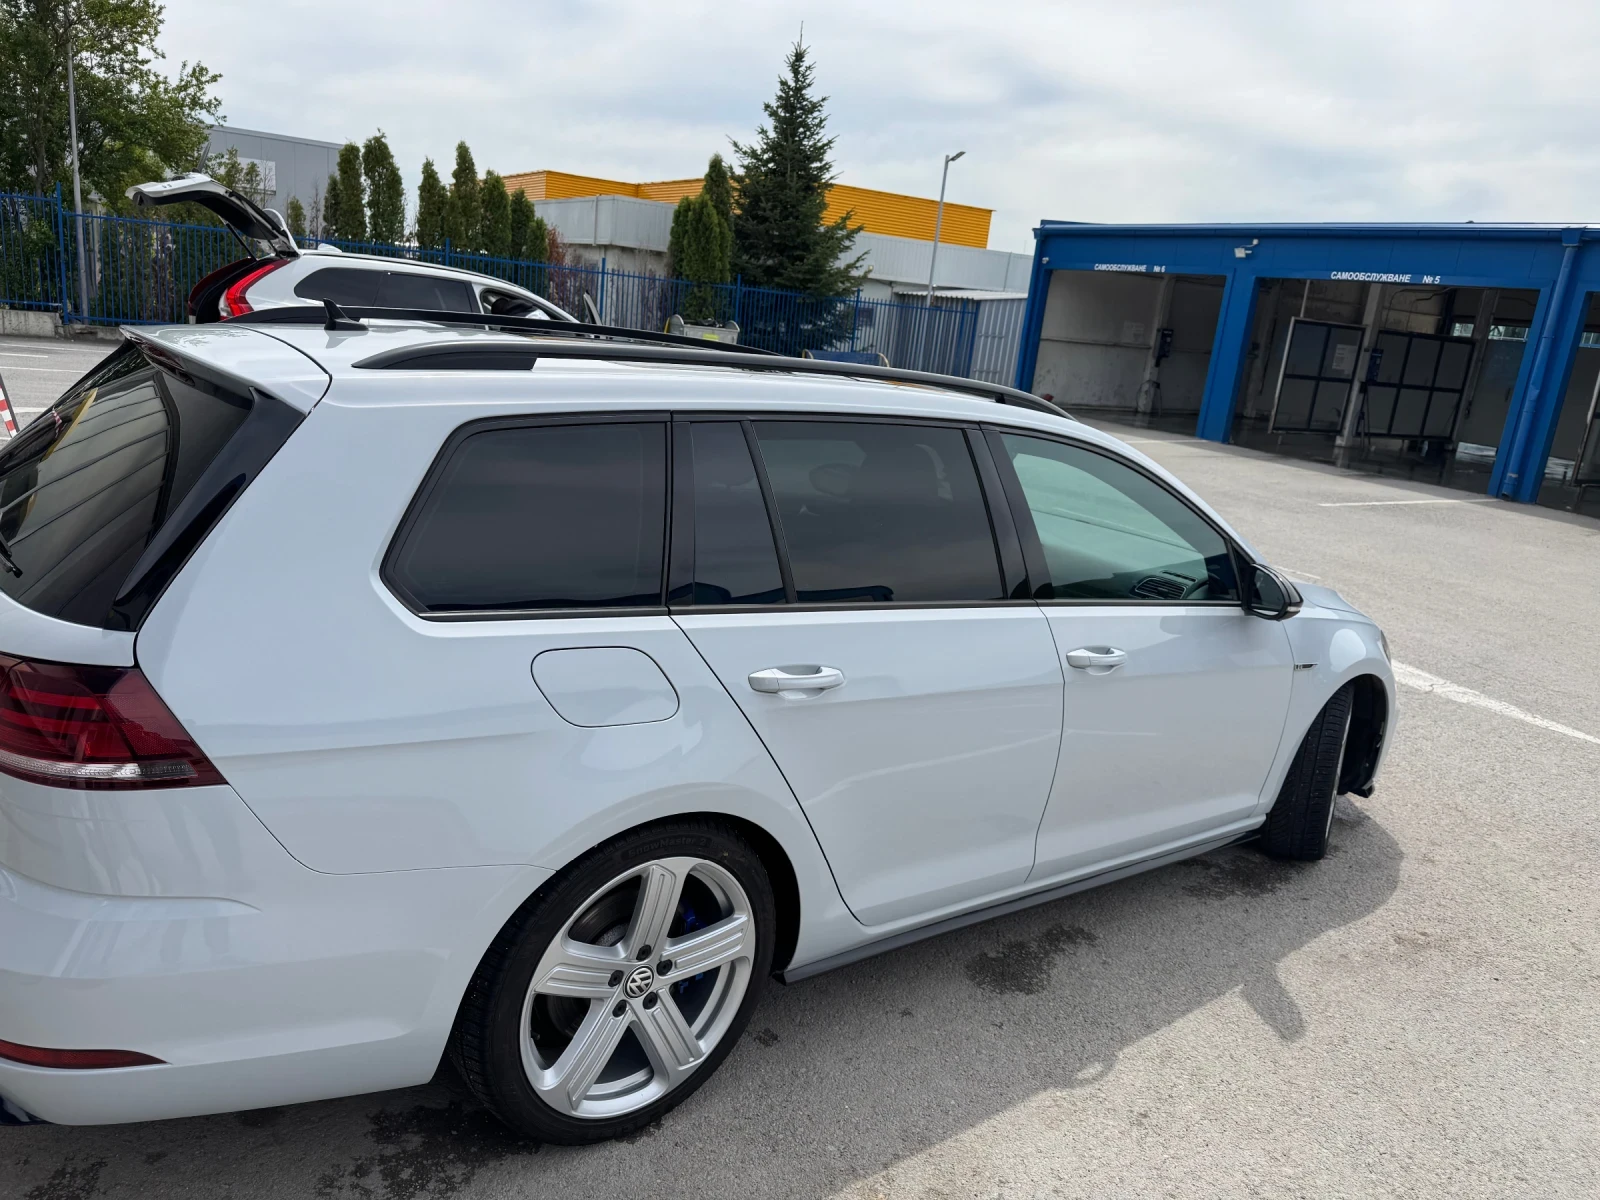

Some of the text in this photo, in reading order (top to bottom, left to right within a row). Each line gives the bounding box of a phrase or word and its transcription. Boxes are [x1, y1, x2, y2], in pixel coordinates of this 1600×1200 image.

[1330, 271, 1411, 283] САМООБСЛУЖВАНЕ
[1434, 275, 1441, 284] 5
[628, 837, 696, 857] SnowMaster
